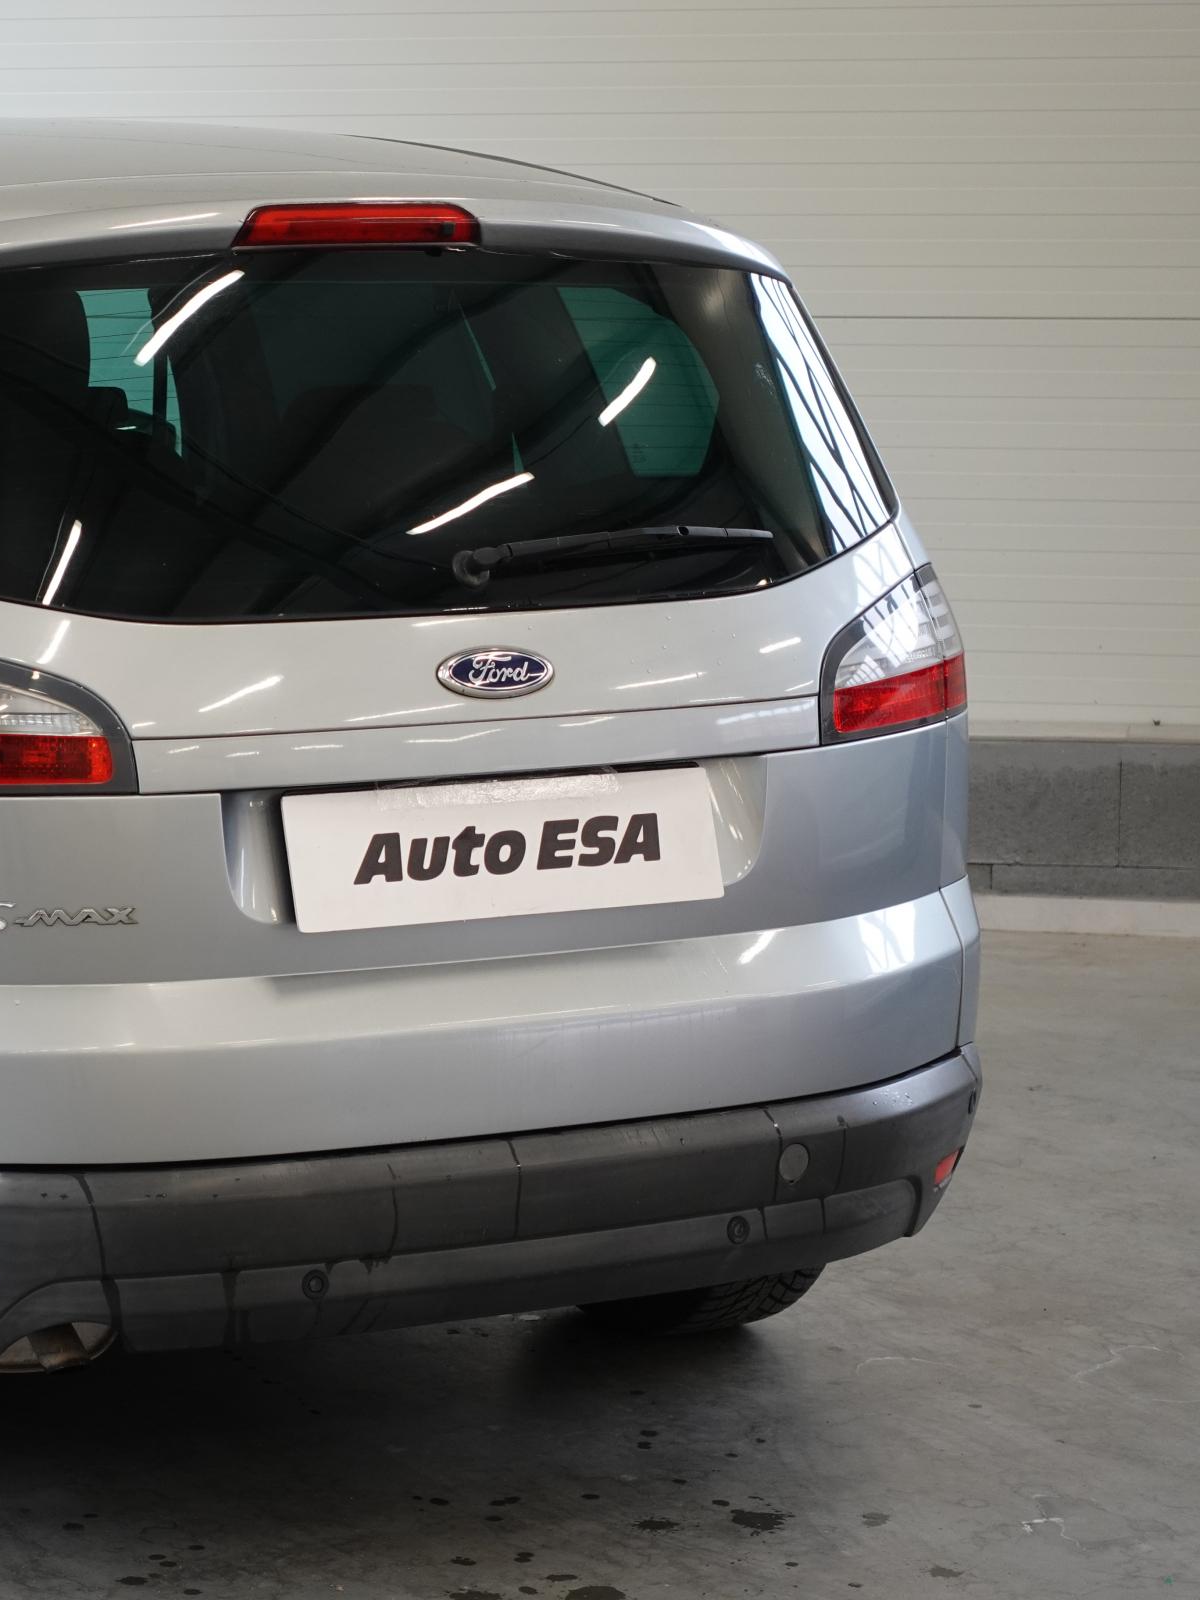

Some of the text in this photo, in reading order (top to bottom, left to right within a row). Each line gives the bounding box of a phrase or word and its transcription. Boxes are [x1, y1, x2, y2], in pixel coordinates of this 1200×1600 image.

[468, 655, 538, 684] Ford
[353, 812, 661, 885] Auto ESA
